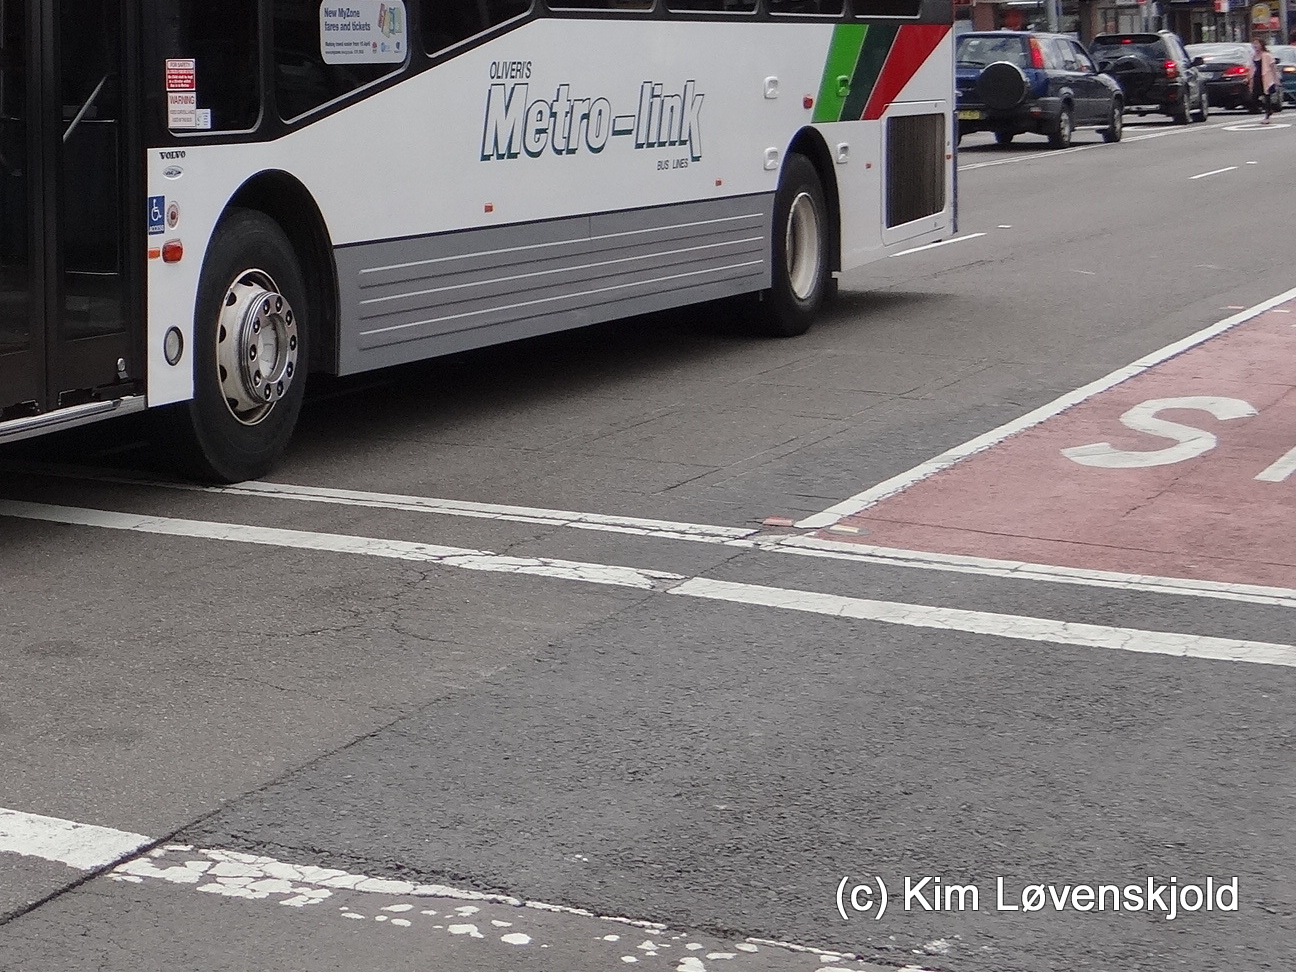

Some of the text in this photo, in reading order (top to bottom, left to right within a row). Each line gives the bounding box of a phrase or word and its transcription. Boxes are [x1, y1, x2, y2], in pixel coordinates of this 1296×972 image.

[324, 7, 360, 19] New MyZone
[324, 21, 371, 31] fares and tickets
[489, 61, 532, 79] OLIVERI'S
[169, 95, 195, 105] WARNING
[479, 79, 705, 162] Metro-link
[159, 150, 186, 160] VOLVO
[656, 158, 689, 171] BUS LINES
